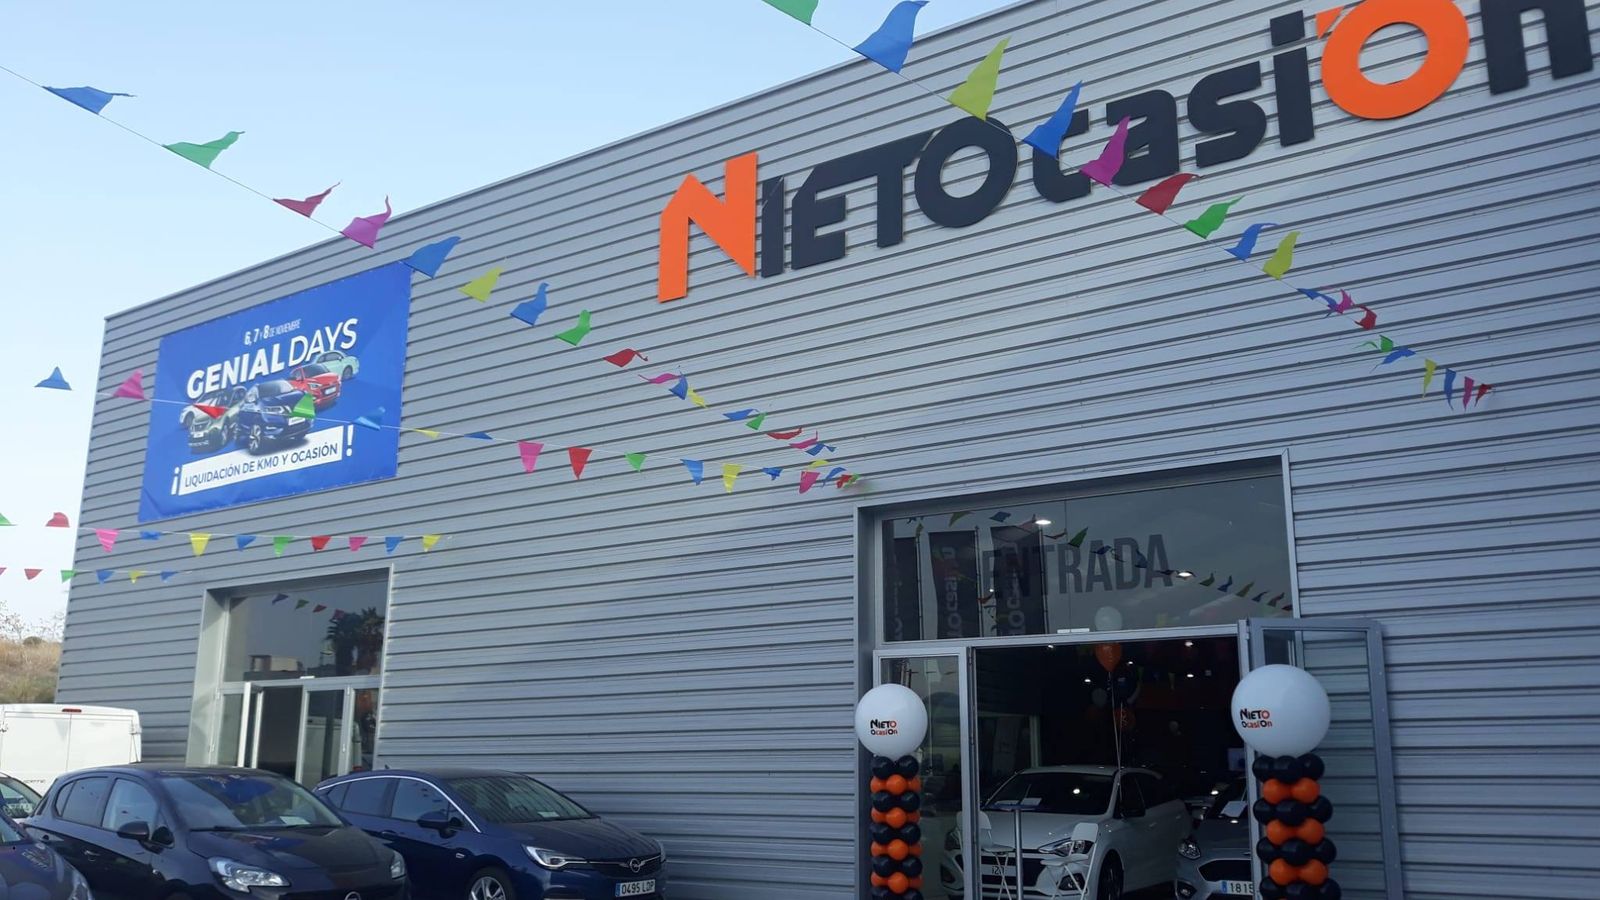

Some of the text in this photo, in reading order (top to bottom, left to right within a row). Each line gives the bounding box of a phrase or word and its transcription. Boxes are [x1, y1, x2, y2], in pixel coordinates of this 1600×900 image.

[186, 318, 358, 399] GENIAL DAYS
[184, 464, 241, 488] LIQUIDACIÓN
[242, 462, 256, 474] DE
[281, 454, 290, 466] Y
[291, 441, 338, 464] OCASIÓN
[982, 534, 1174, 597] ENTRADA
[870, 719, 897, 729] NIETO
